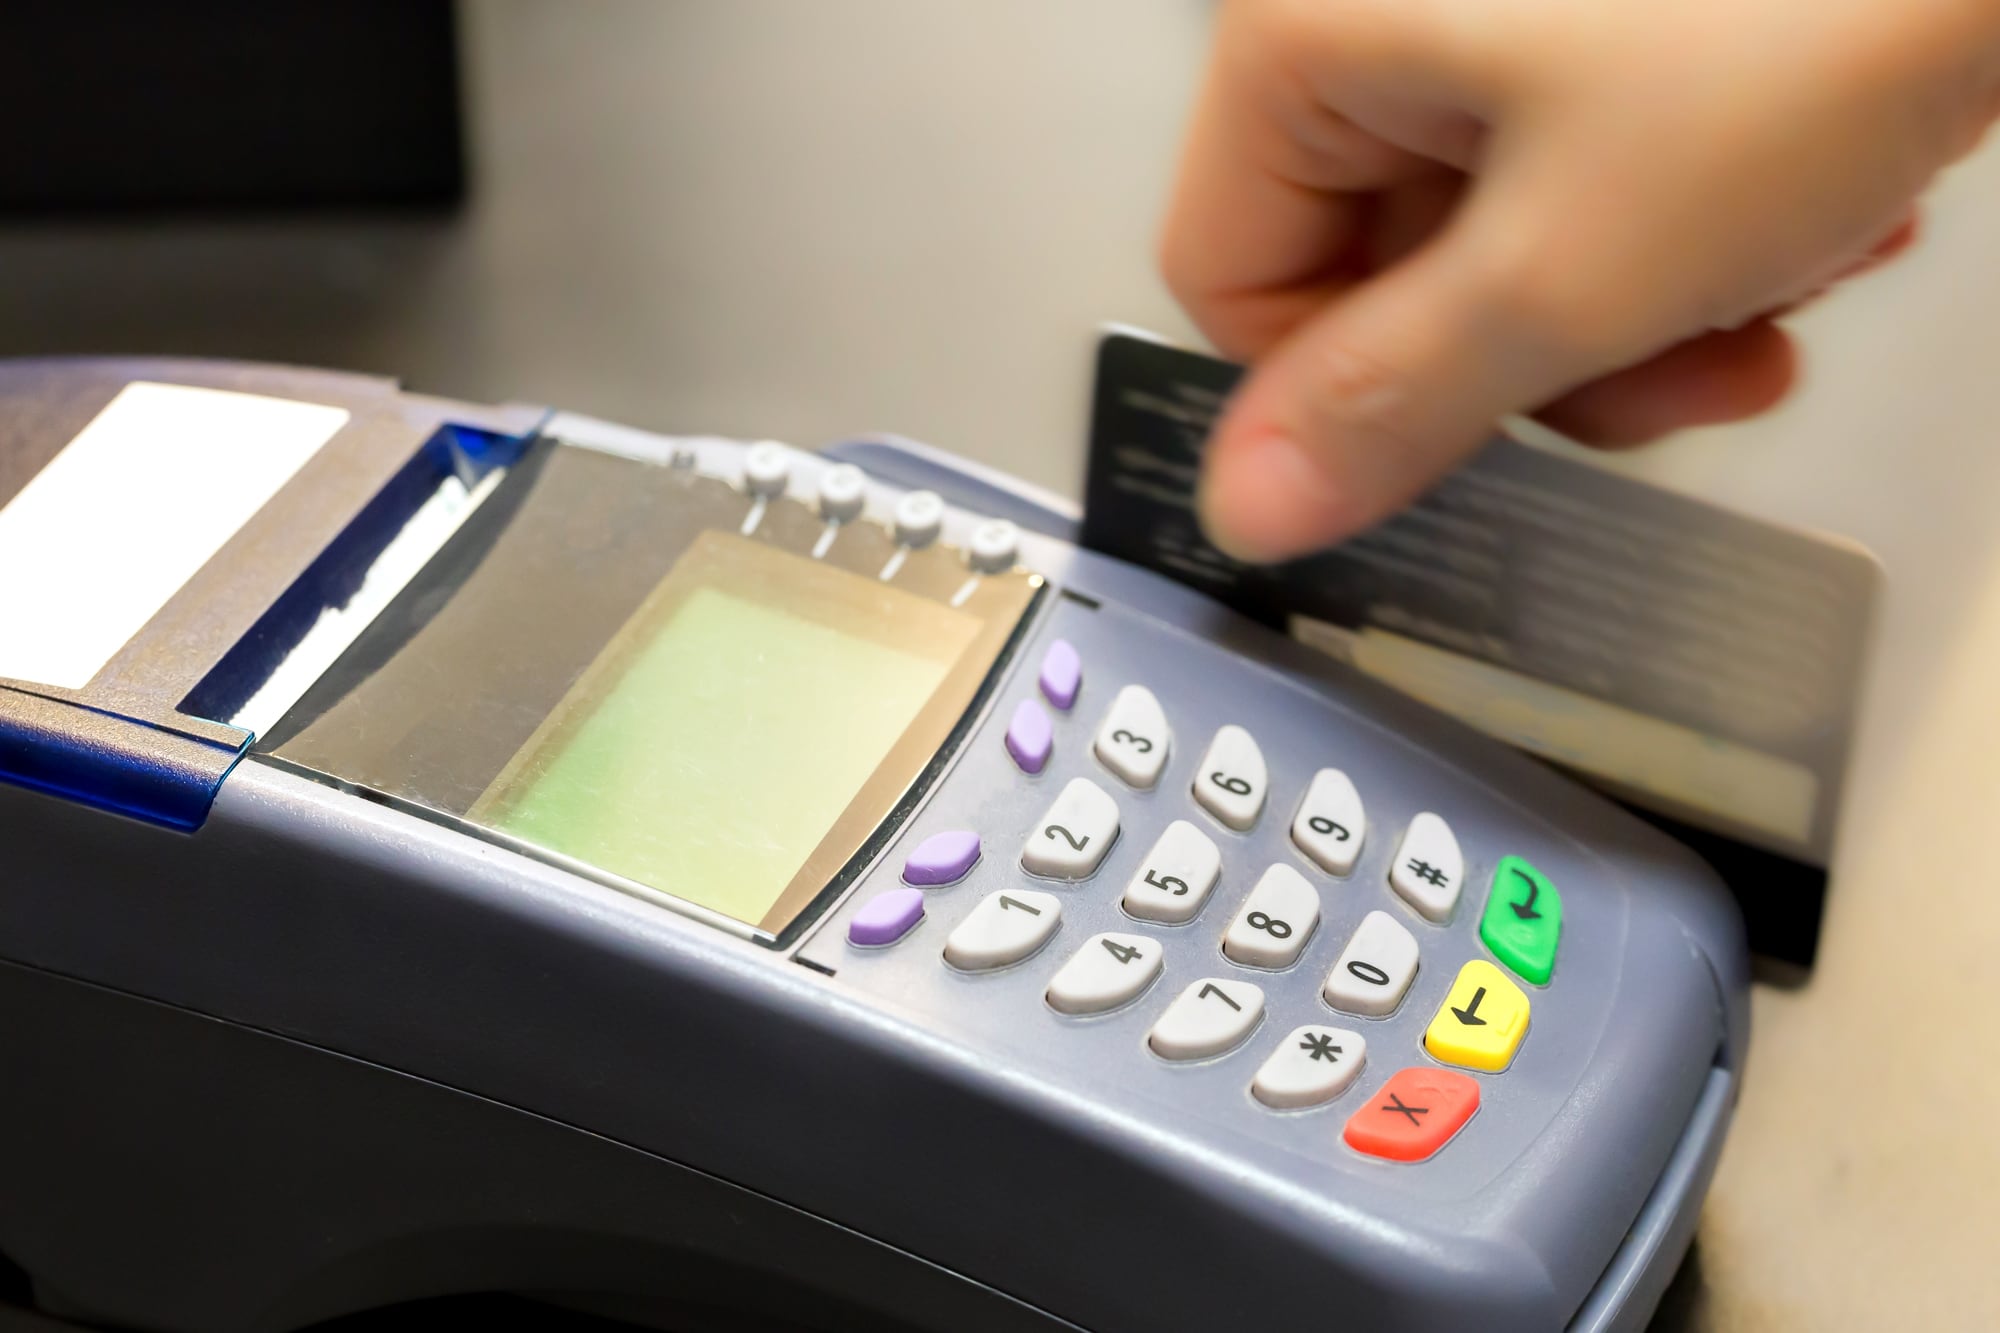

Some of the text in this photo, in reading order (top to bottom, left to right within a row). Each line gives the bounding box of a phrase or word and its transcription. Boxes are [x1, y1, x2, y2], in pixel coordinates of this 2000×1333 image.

[1112, 729, 1153, 754] 3
[1210, 771, 1252, 796] 6
[1044, 824, 1090, 852] 2
[1308, 816, 1350, 842] 9
[1143, 869, 1189, 896] 5
[1407, 858, 1449, 888] #
[999, 895, 1042, 917] 1
[1246, 911, 1293, 939] 8
[1101, 938, 1143, 965] 4
[1346, 960, 1390, 986] 0
[1198, 983, 1242, 1012] 7
